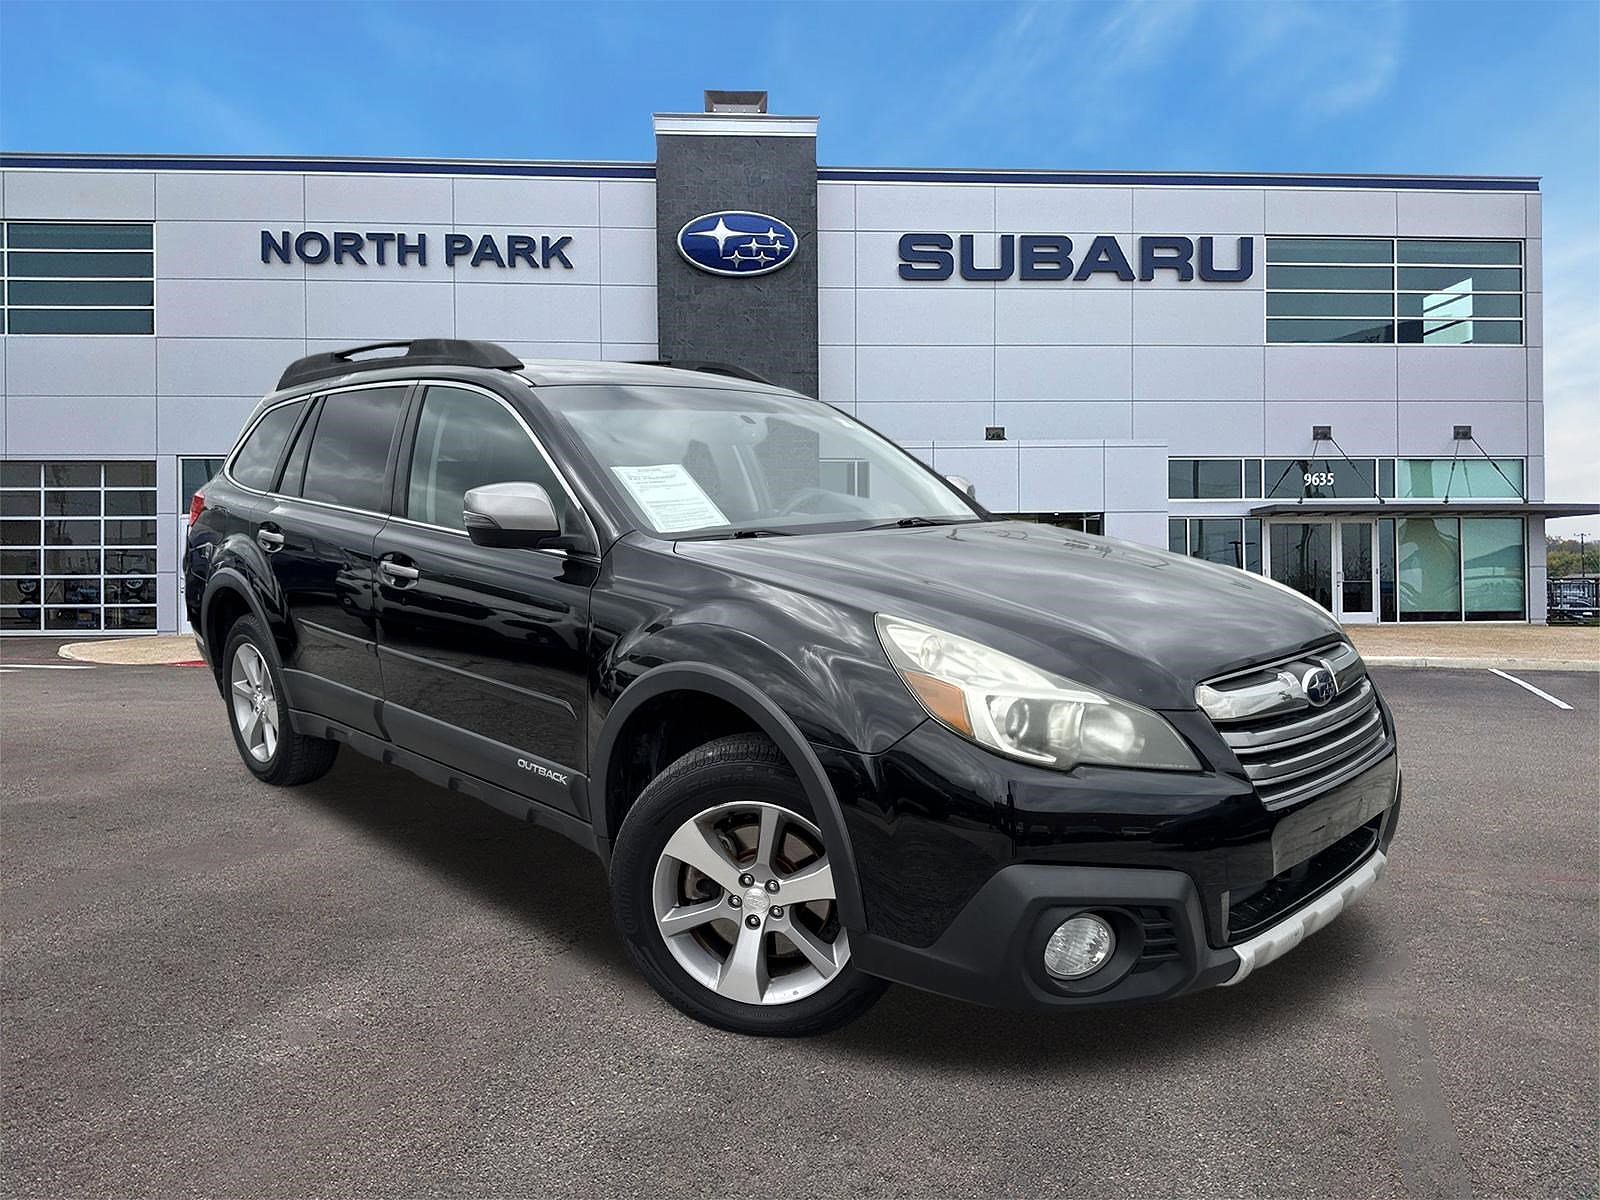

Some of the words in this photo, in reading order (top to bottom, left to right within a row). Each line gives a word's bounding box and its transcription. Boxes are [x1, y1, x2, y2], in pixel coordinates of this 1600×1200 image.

[261, 230, 427, 266] NORTH
[445, 233, 574, 269] PARK
[898, 233, 1254, 282] SUBARU
[1303, 472, 1335, 486] 9635
[517, 758, 567, 785] OUTBACK
